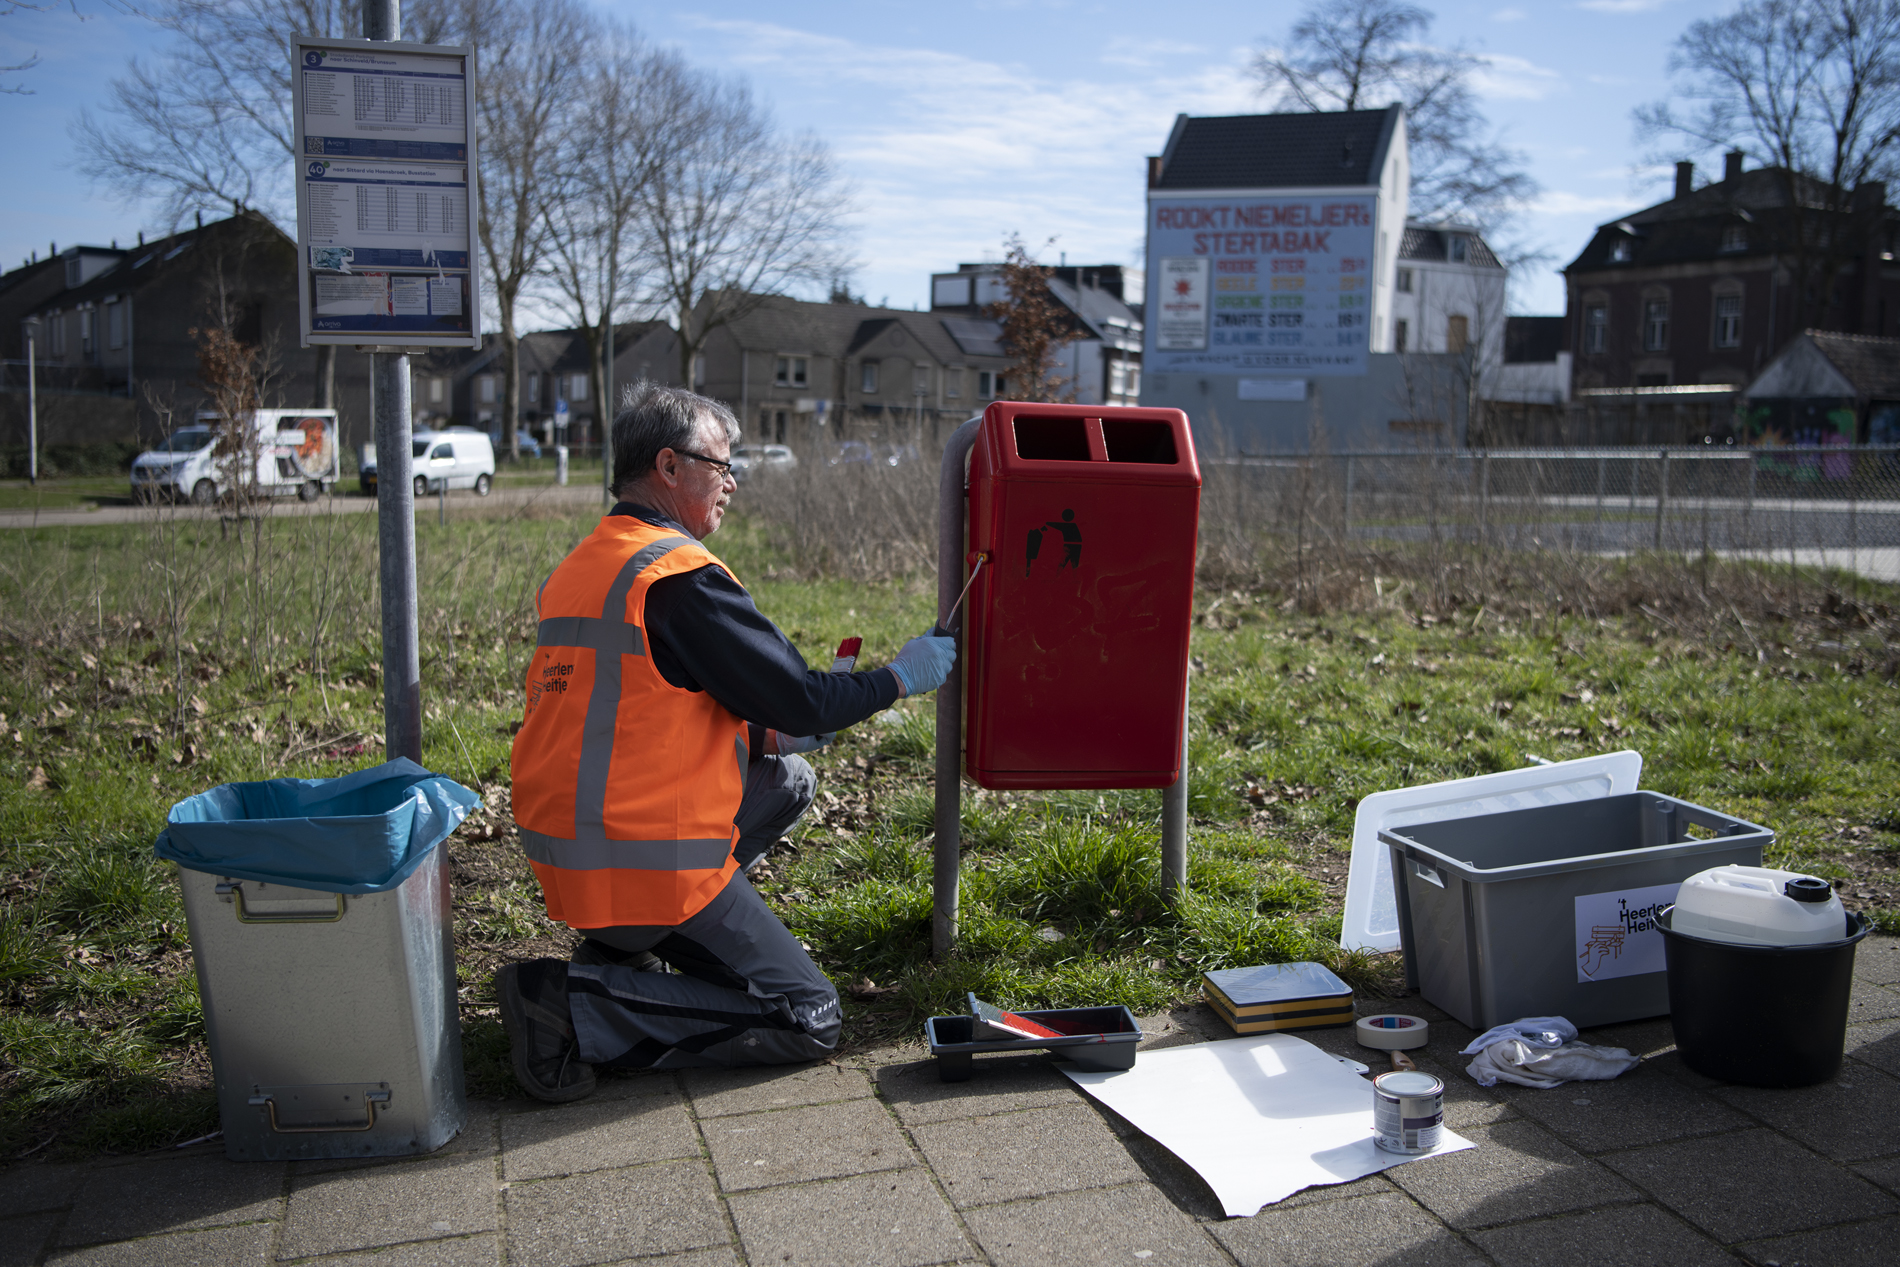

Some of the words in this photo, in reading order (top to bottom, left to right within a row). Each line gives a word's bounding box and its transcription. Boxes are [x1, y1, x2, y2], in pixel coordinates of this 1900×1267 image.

[310, 54, 317, 64] 3
[309, 165, 324, 174] 40
[1156, 206, 1231, 230] ROOKT
[1193, 230, 1331, 255] STERTABAK
[543, 678, 567, 694] eitje
[1627, 918, 1656, 934] Heit
